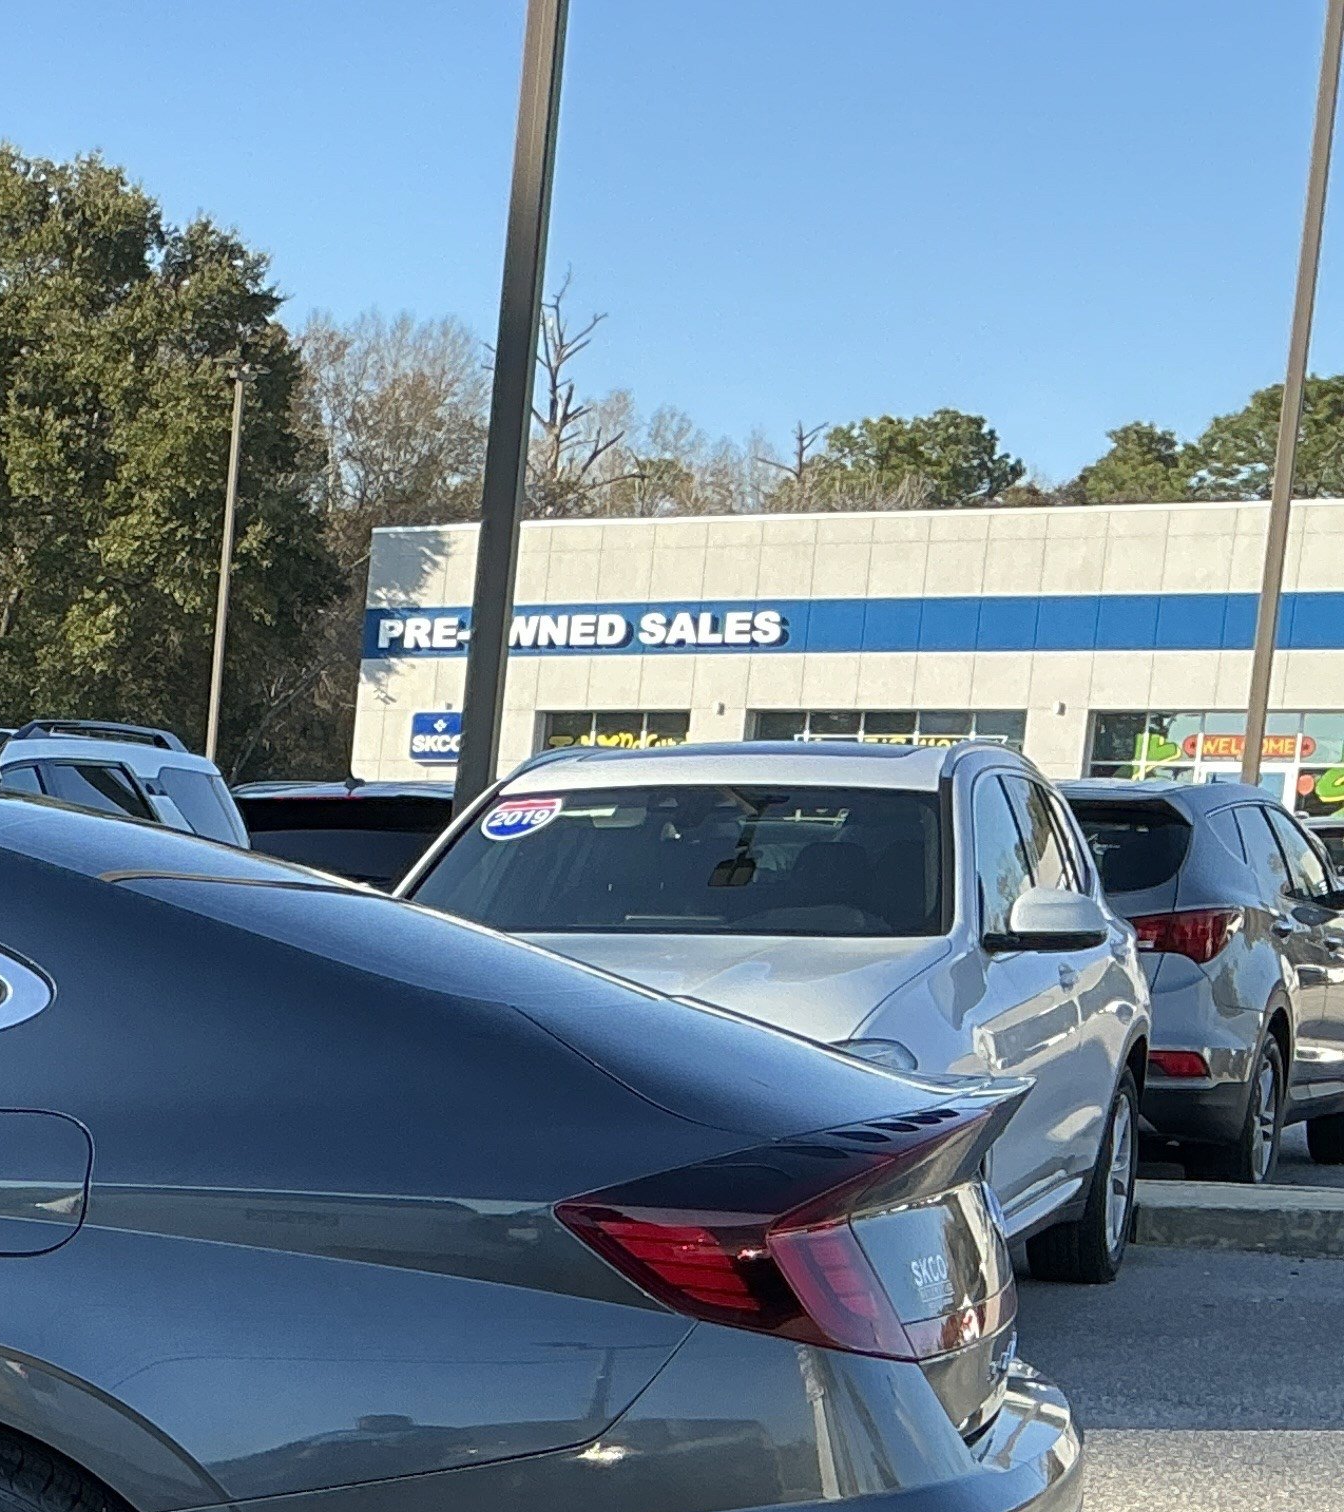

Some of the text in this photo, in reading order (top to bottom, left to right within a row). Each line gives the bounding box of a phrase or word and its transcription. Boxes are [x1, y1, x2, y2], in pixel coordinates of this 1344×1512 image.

[377, 611, 783, 649] PRE-WNED SALES
[1202, 737, 1295, 754] WELOME
[487, 809, 551, 827] 2019
[911, 1254, 947, 1287] SKCO
